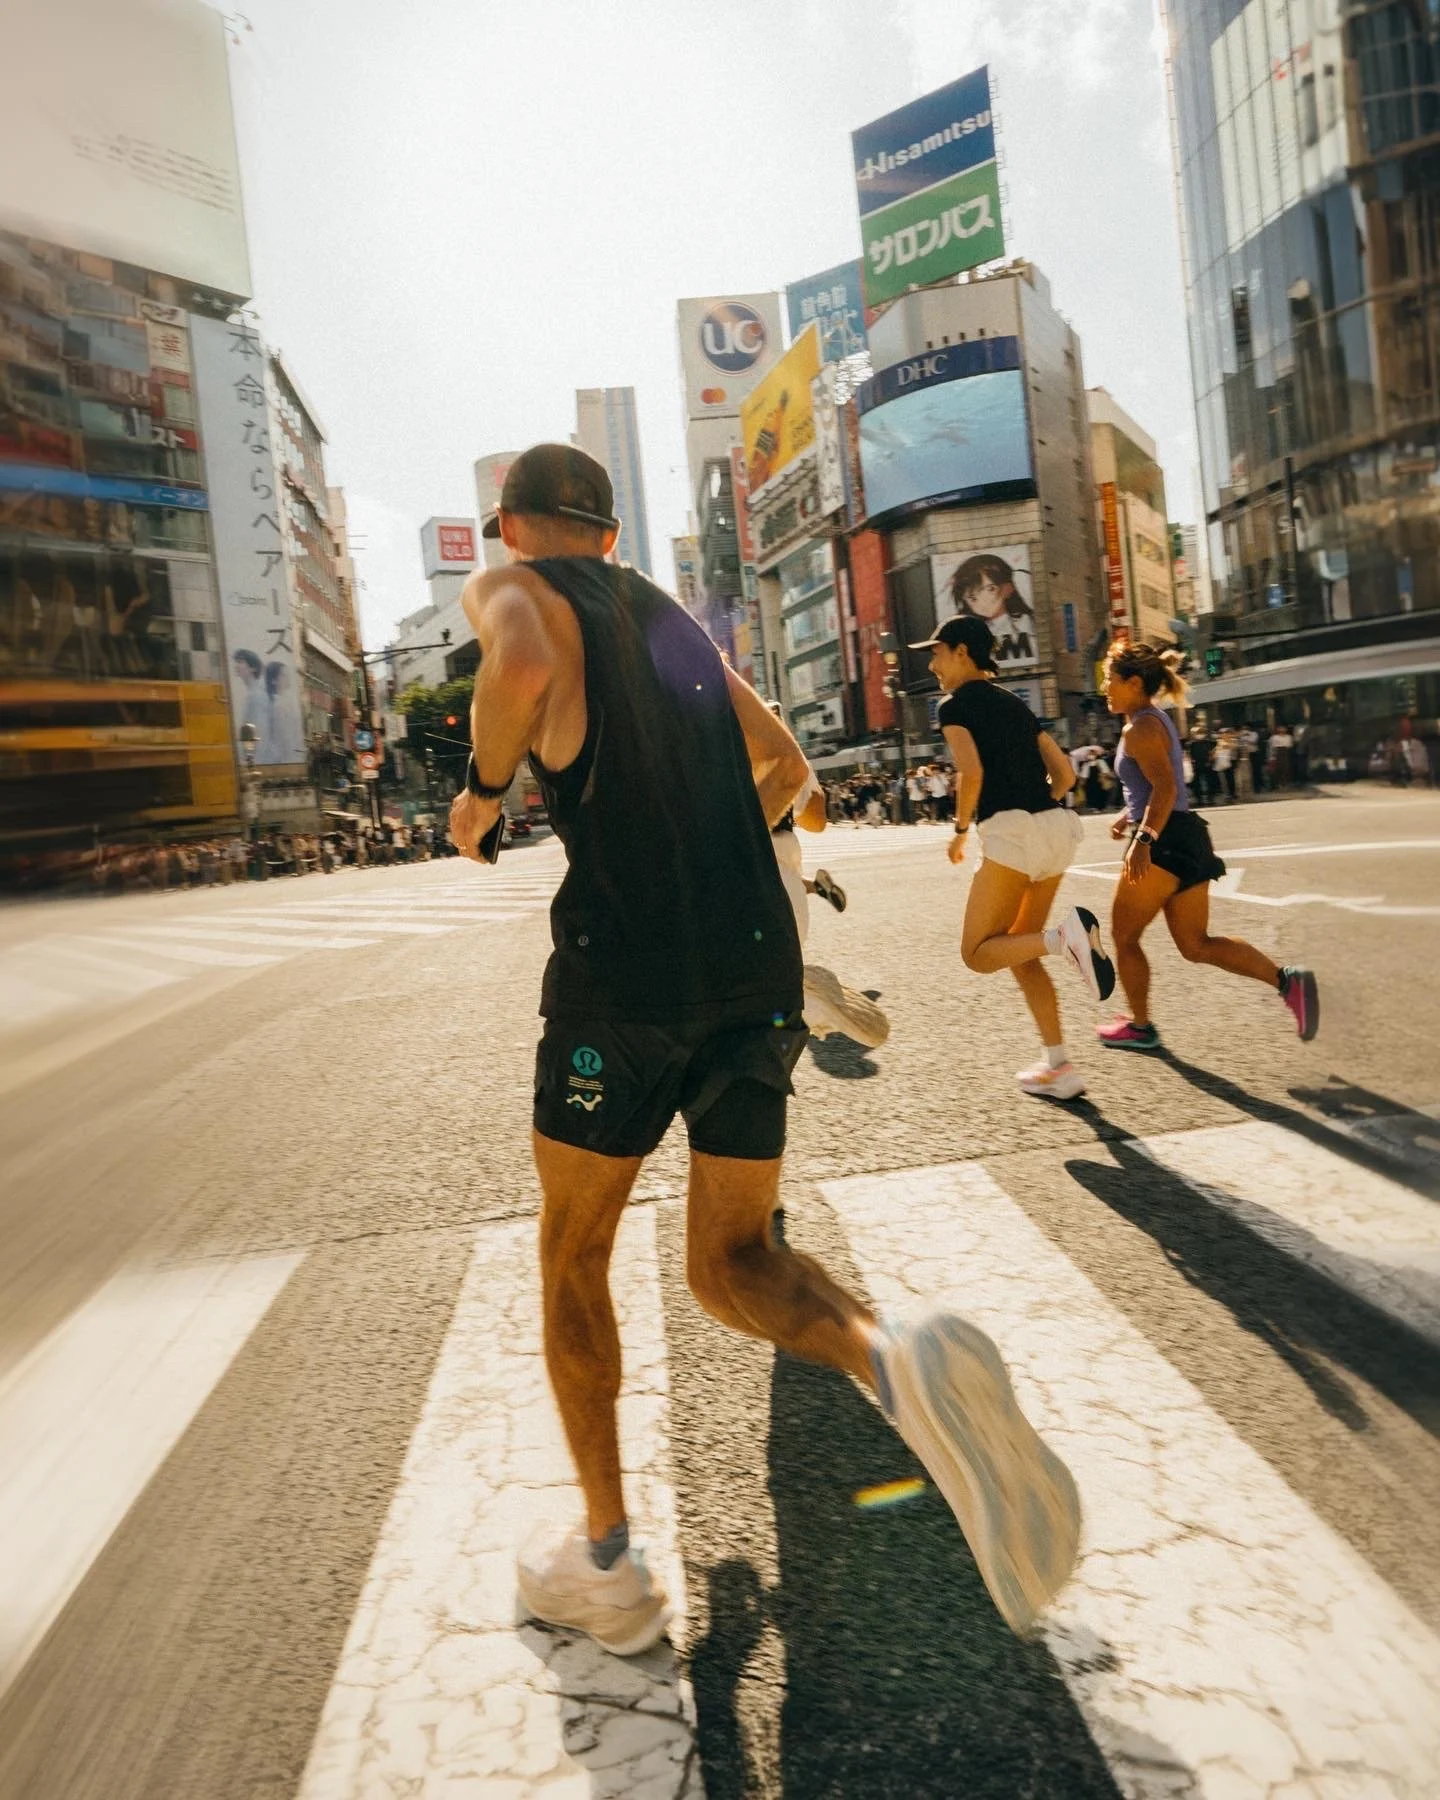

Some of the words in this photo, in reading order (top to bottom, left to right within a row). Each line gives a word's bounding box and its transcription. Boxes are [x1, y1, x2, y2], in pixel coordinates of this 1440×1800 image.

[857, 110, 992, 180] Hisamitsu
[868, 194, 995, 275] サロンパス
[897, 354, 949, 386] DHC
